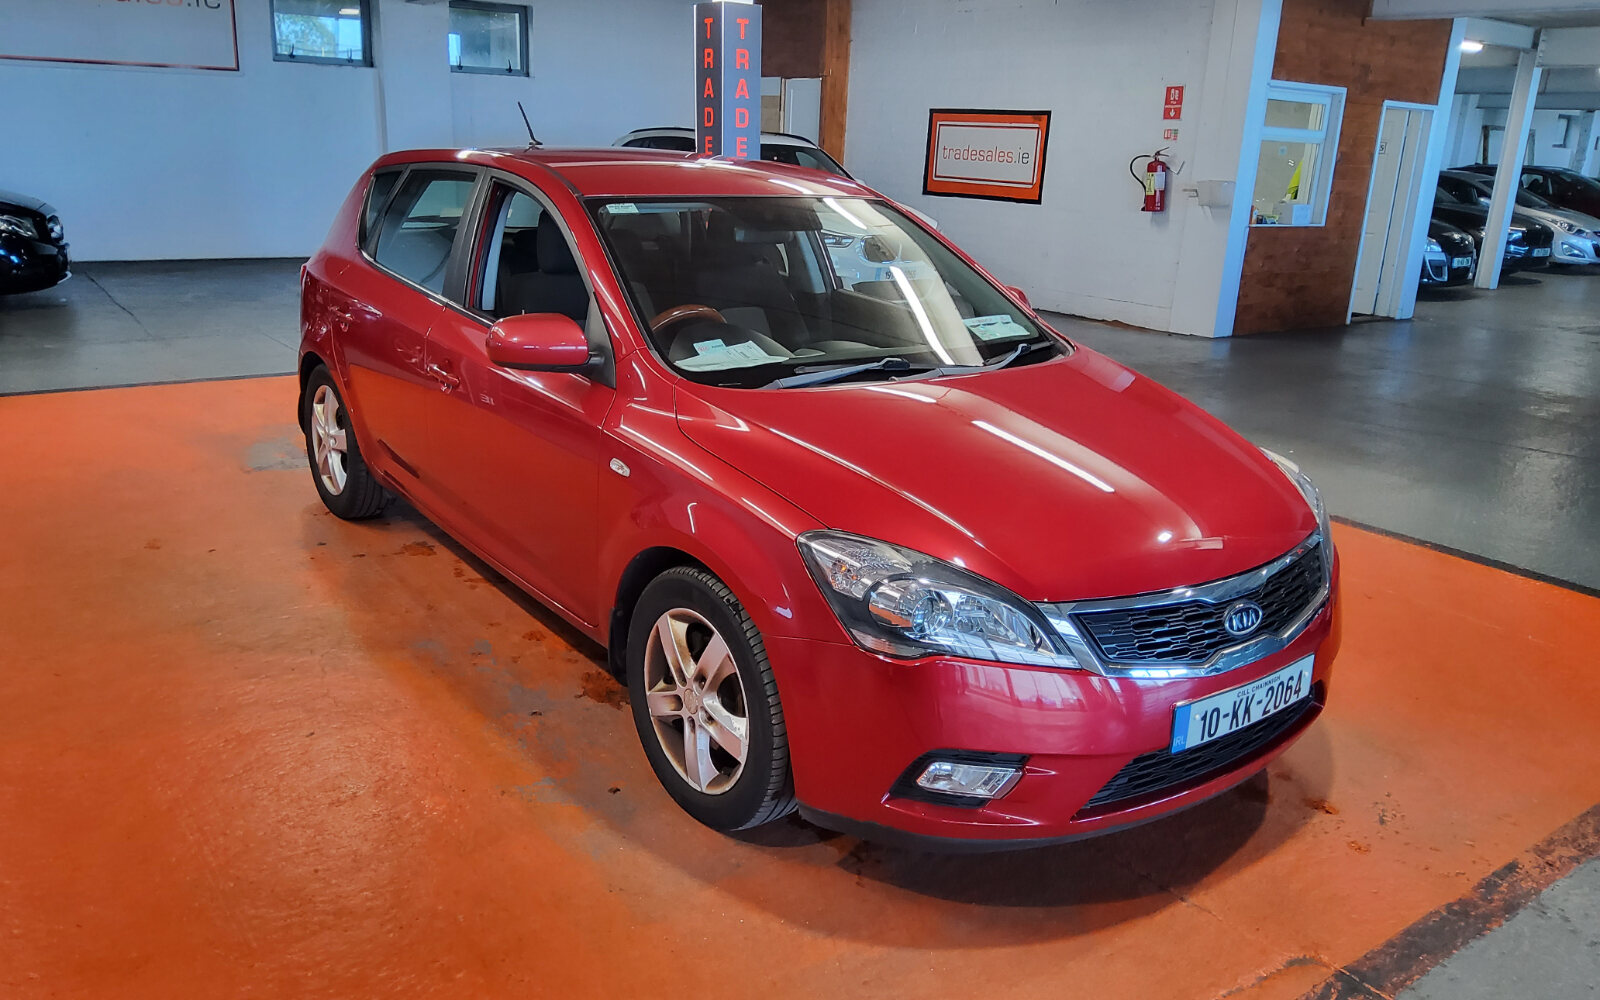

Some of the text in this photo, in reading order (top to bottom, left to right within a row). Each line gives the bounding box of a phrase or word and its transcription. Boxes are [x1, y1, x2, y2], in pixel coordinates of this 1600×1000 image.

[704, 17, 714, 155] TRADE
[735, 18, 750, 157] TRADE
[942, 144, 1030, 165] tradesales.ie
[1231, 608, 1257, 631] KIA
[1236, 688, 1250, 698] CILL
[1200, 670, 1304, 741] 10-KK-2064
[1173, 735, 1185, 745] IRL
